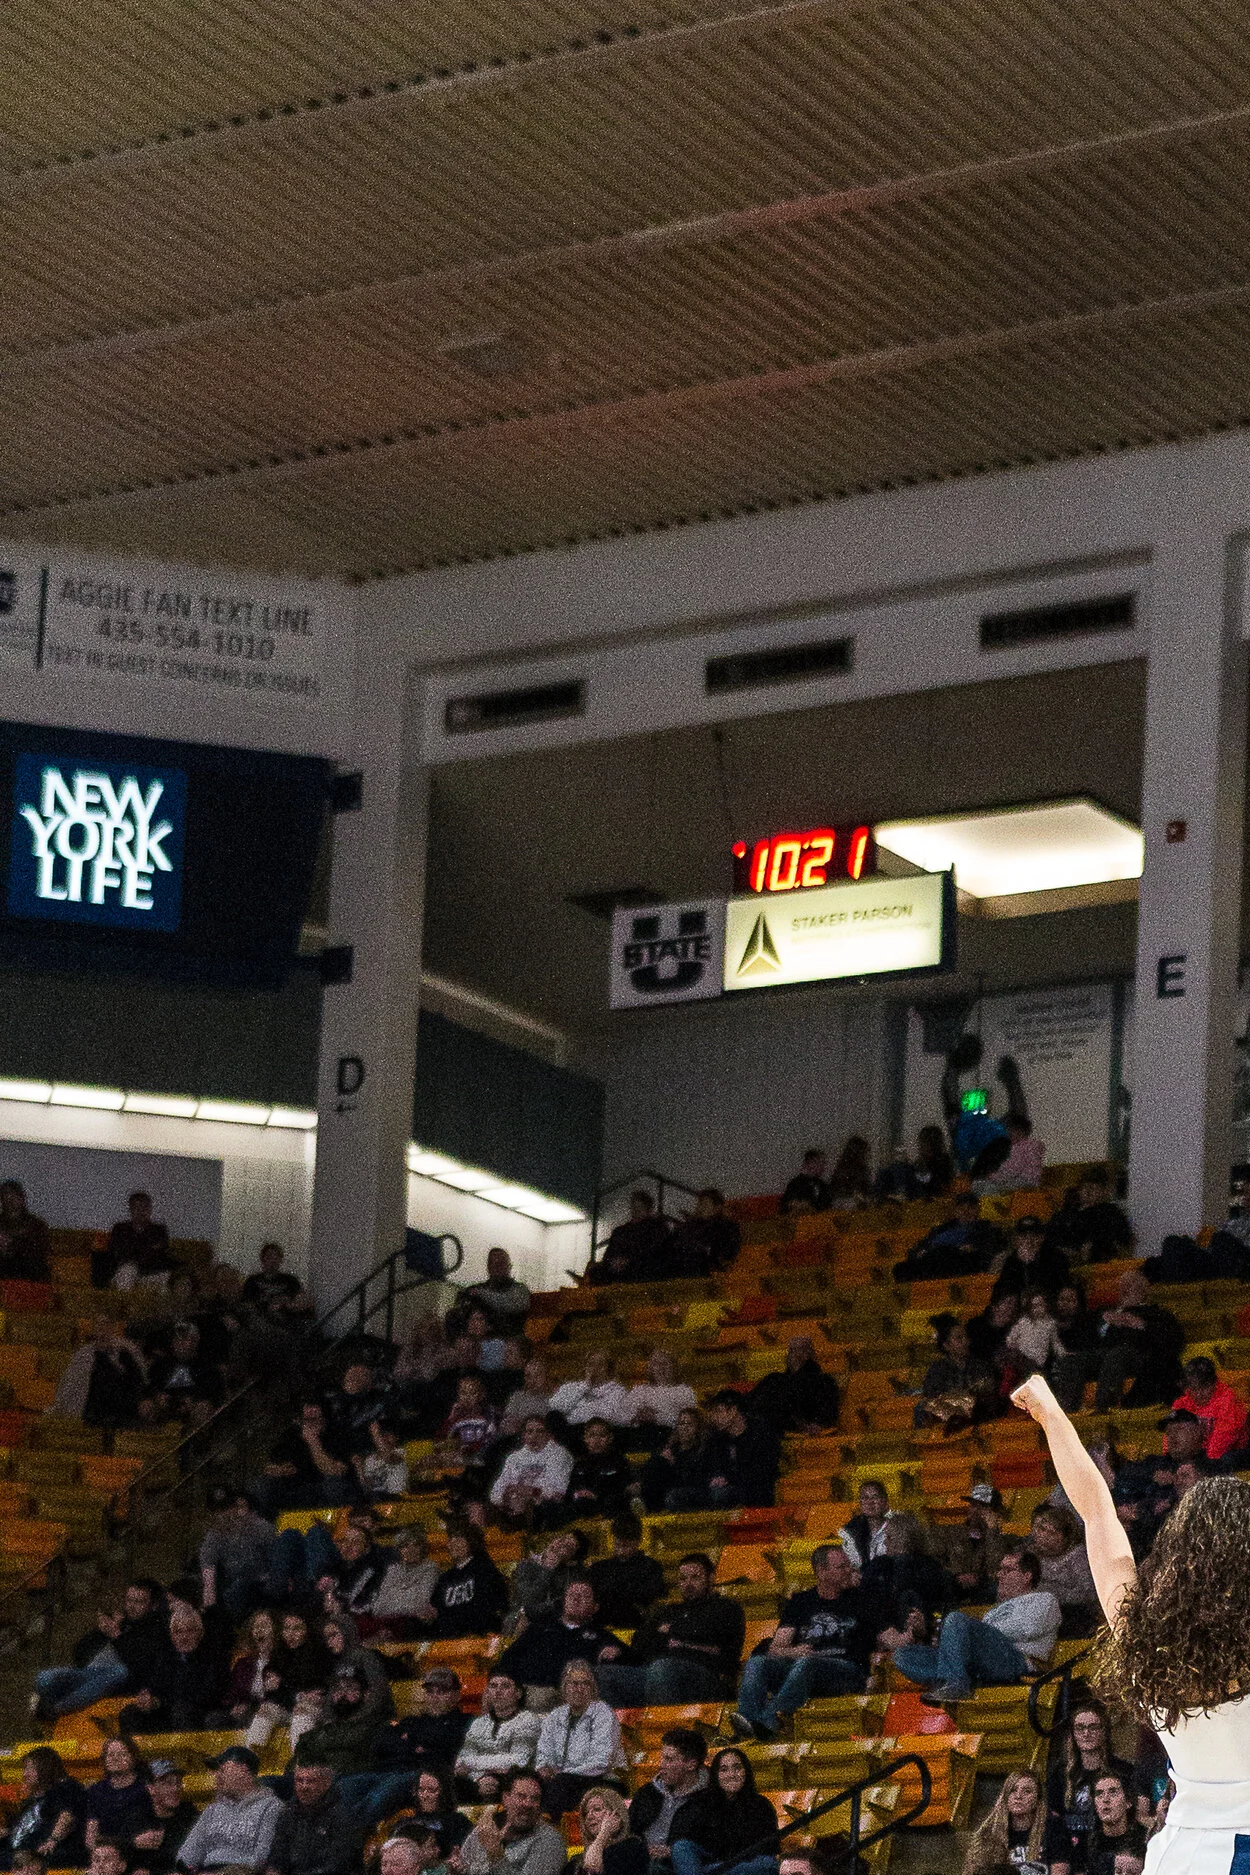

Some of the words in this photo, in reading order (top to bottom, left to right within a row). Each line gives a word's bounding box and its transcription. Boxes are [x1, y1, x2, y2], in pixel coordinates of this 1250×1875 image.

[59, 577, 134, 613] AGGIE
[142, 587, 192, 620] FAN
[199, 594, 255, 628] TEXT
[262, 603, 314, 637] LINE
[40, 765, 164, 820] NEW
[19, 803, 174, 873] YORK
[36, 853, 154, 910] LIFE
[623, 933, 712, 969] STATE
[1157, 954, 1188, 1000] E
[336, 1057, 365, 1095] D
